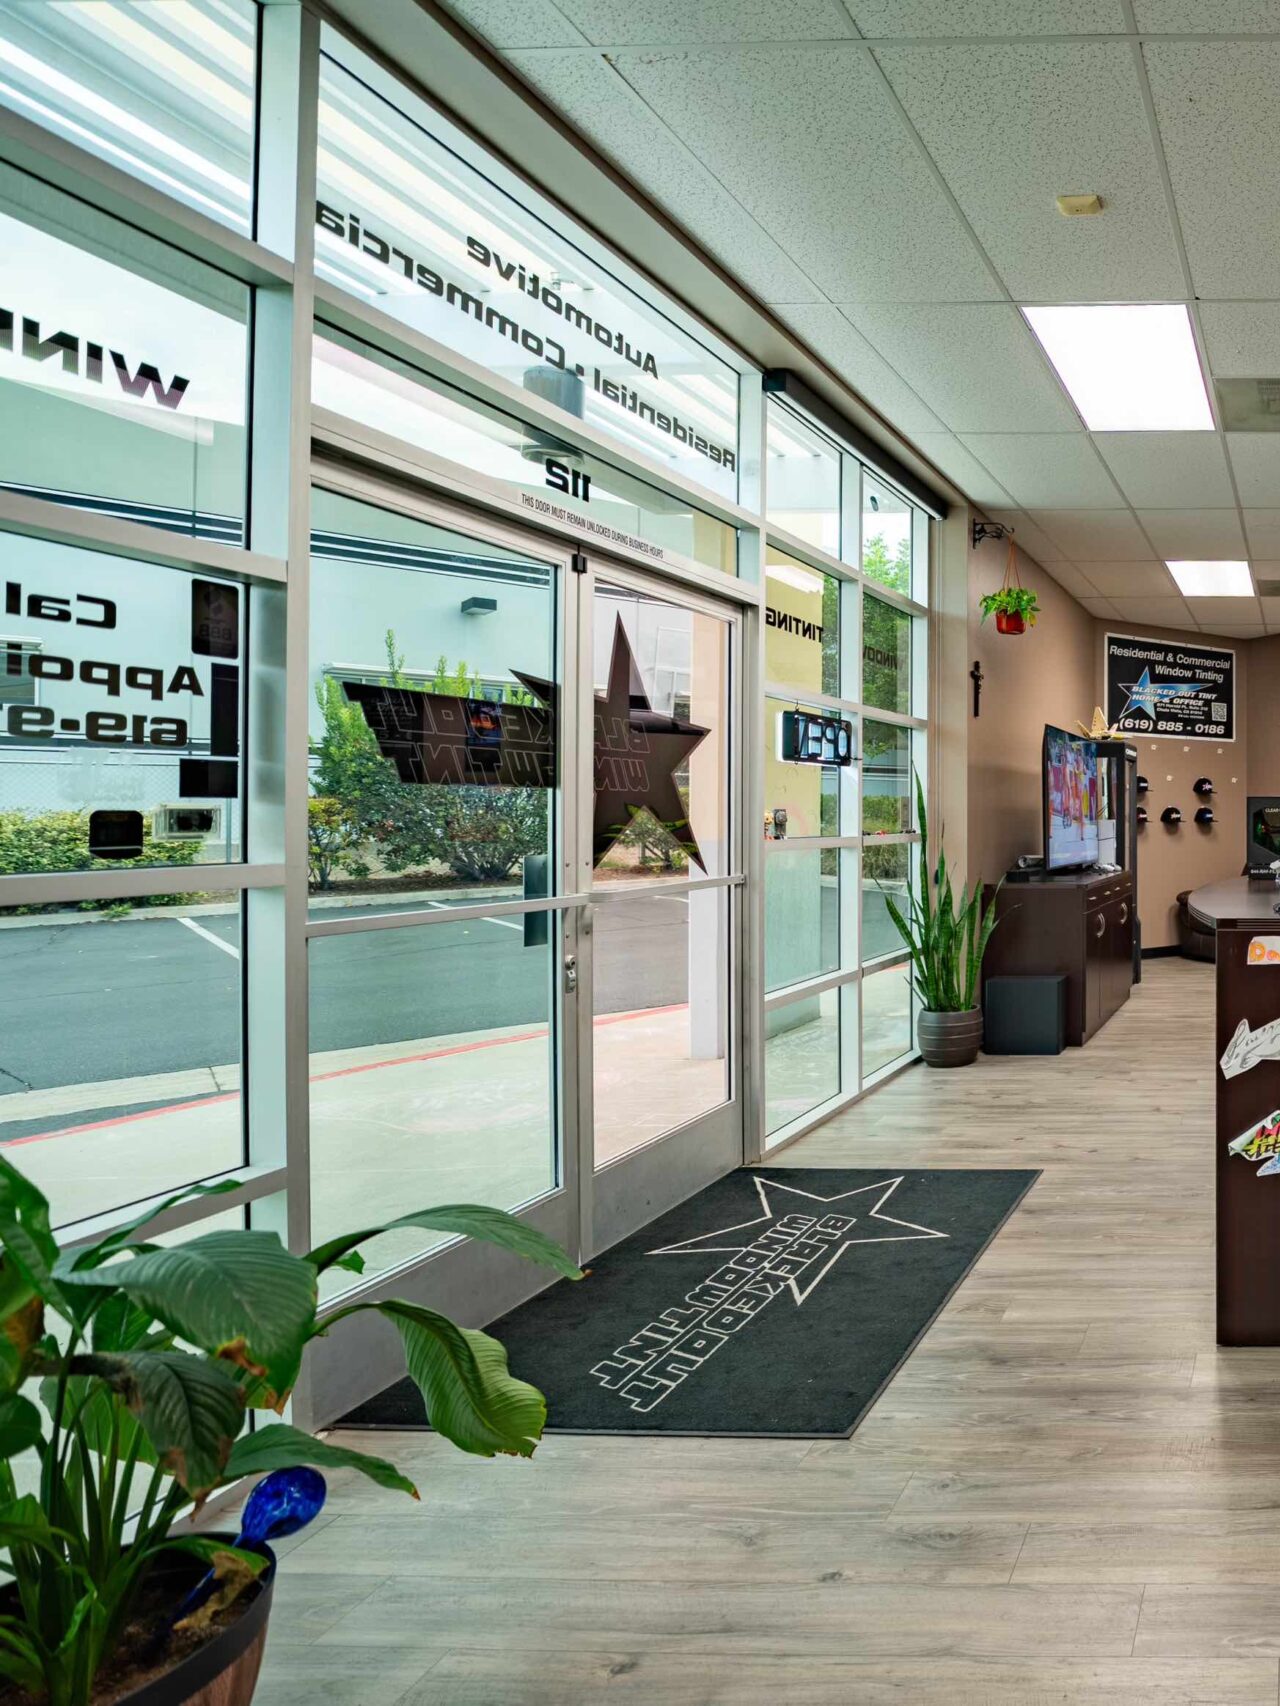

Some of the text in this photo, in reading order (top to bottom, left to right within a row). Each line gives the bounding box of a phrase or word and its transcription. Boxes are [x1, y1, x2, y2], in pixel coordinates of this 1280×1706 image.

[521, 493, 664, 559] THIS DOOR MUST REMAIN UNLOCKED DURING BUSINESS HOURS
[1109, 645, 1231, 669] Residential & Commercial
[1155, 664, 1224, 683] Window Tinting
[1131, 686, 1176, 696] BLACKED
[1177, 690, 1196, 698] OUT
[1131, 694, 1160, 703] HOME
[1173, 697, 1205, 706] OFFICE
[1119, 718, 1153, 732] (619)
[1157, 720, 1184, 732] 885
[1195, 723, 1225, 735] 0186
